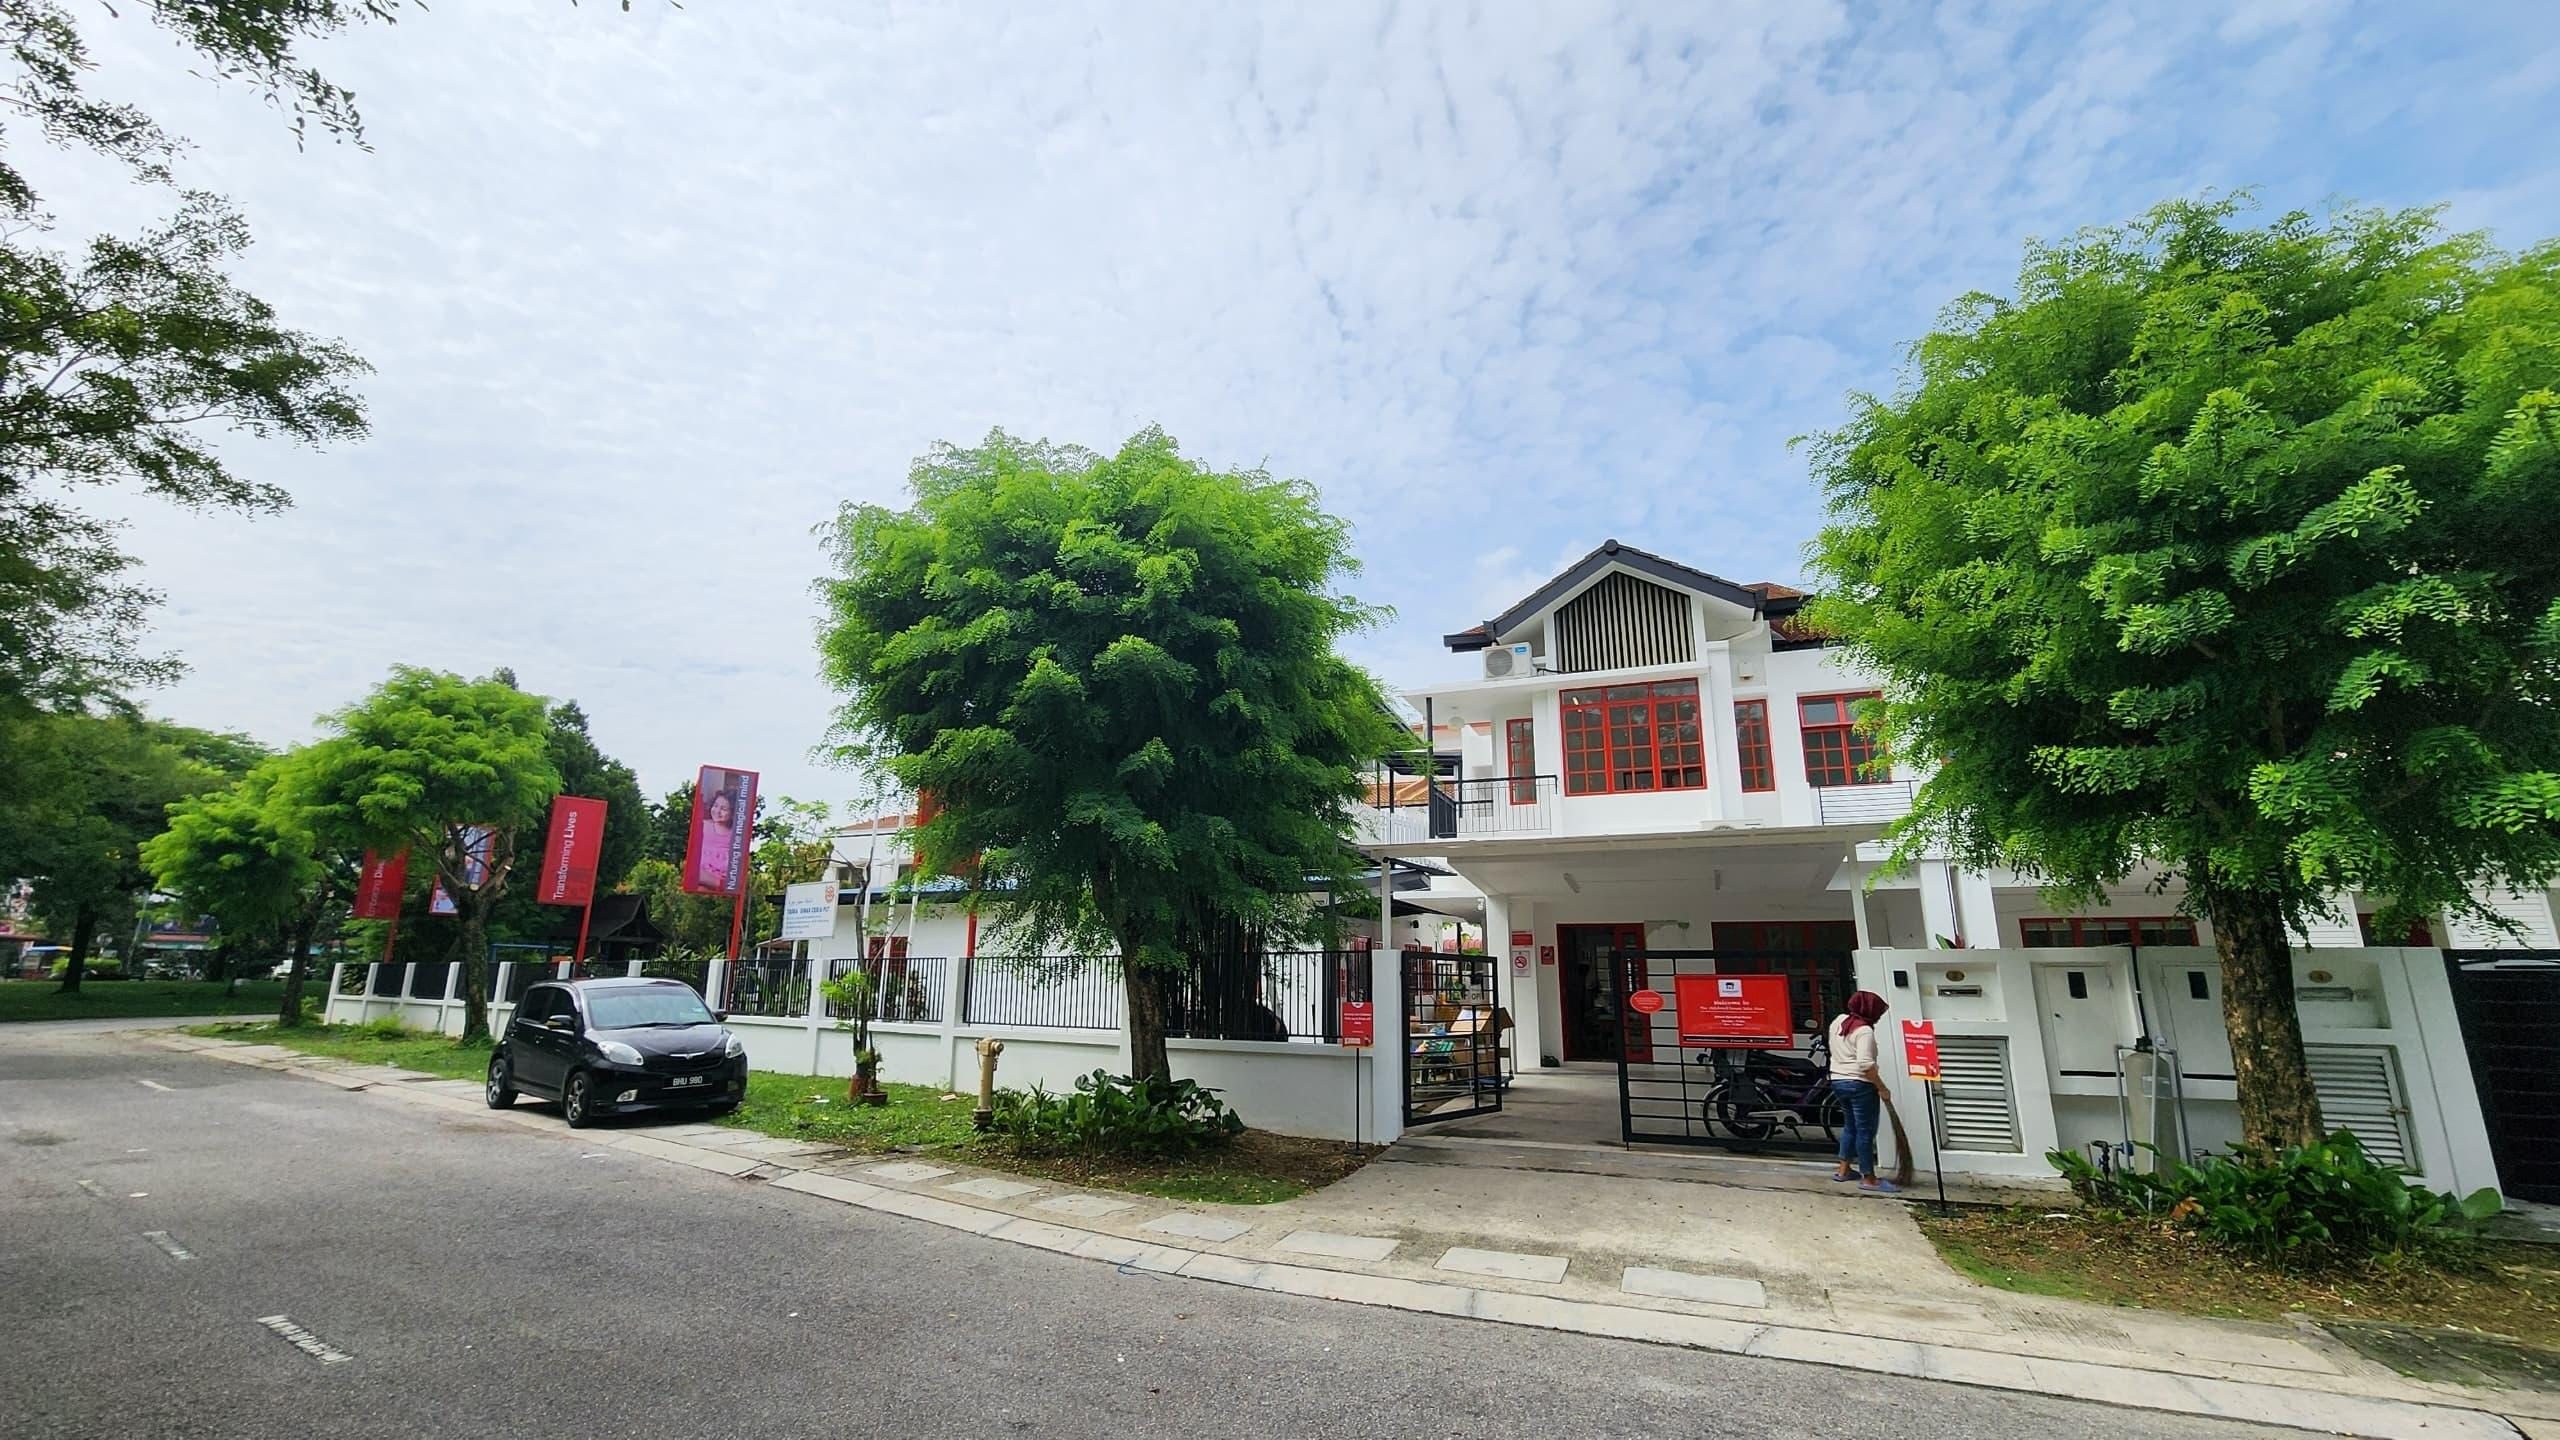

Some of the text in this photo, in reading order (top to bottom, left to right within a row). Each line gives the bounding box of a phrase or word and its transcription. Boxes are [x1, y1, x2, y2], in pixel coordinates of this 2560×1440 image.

[552, 811, 578, 900] Transforming Lives
[727, 775, 750, 890] Nurturing the magical mind
